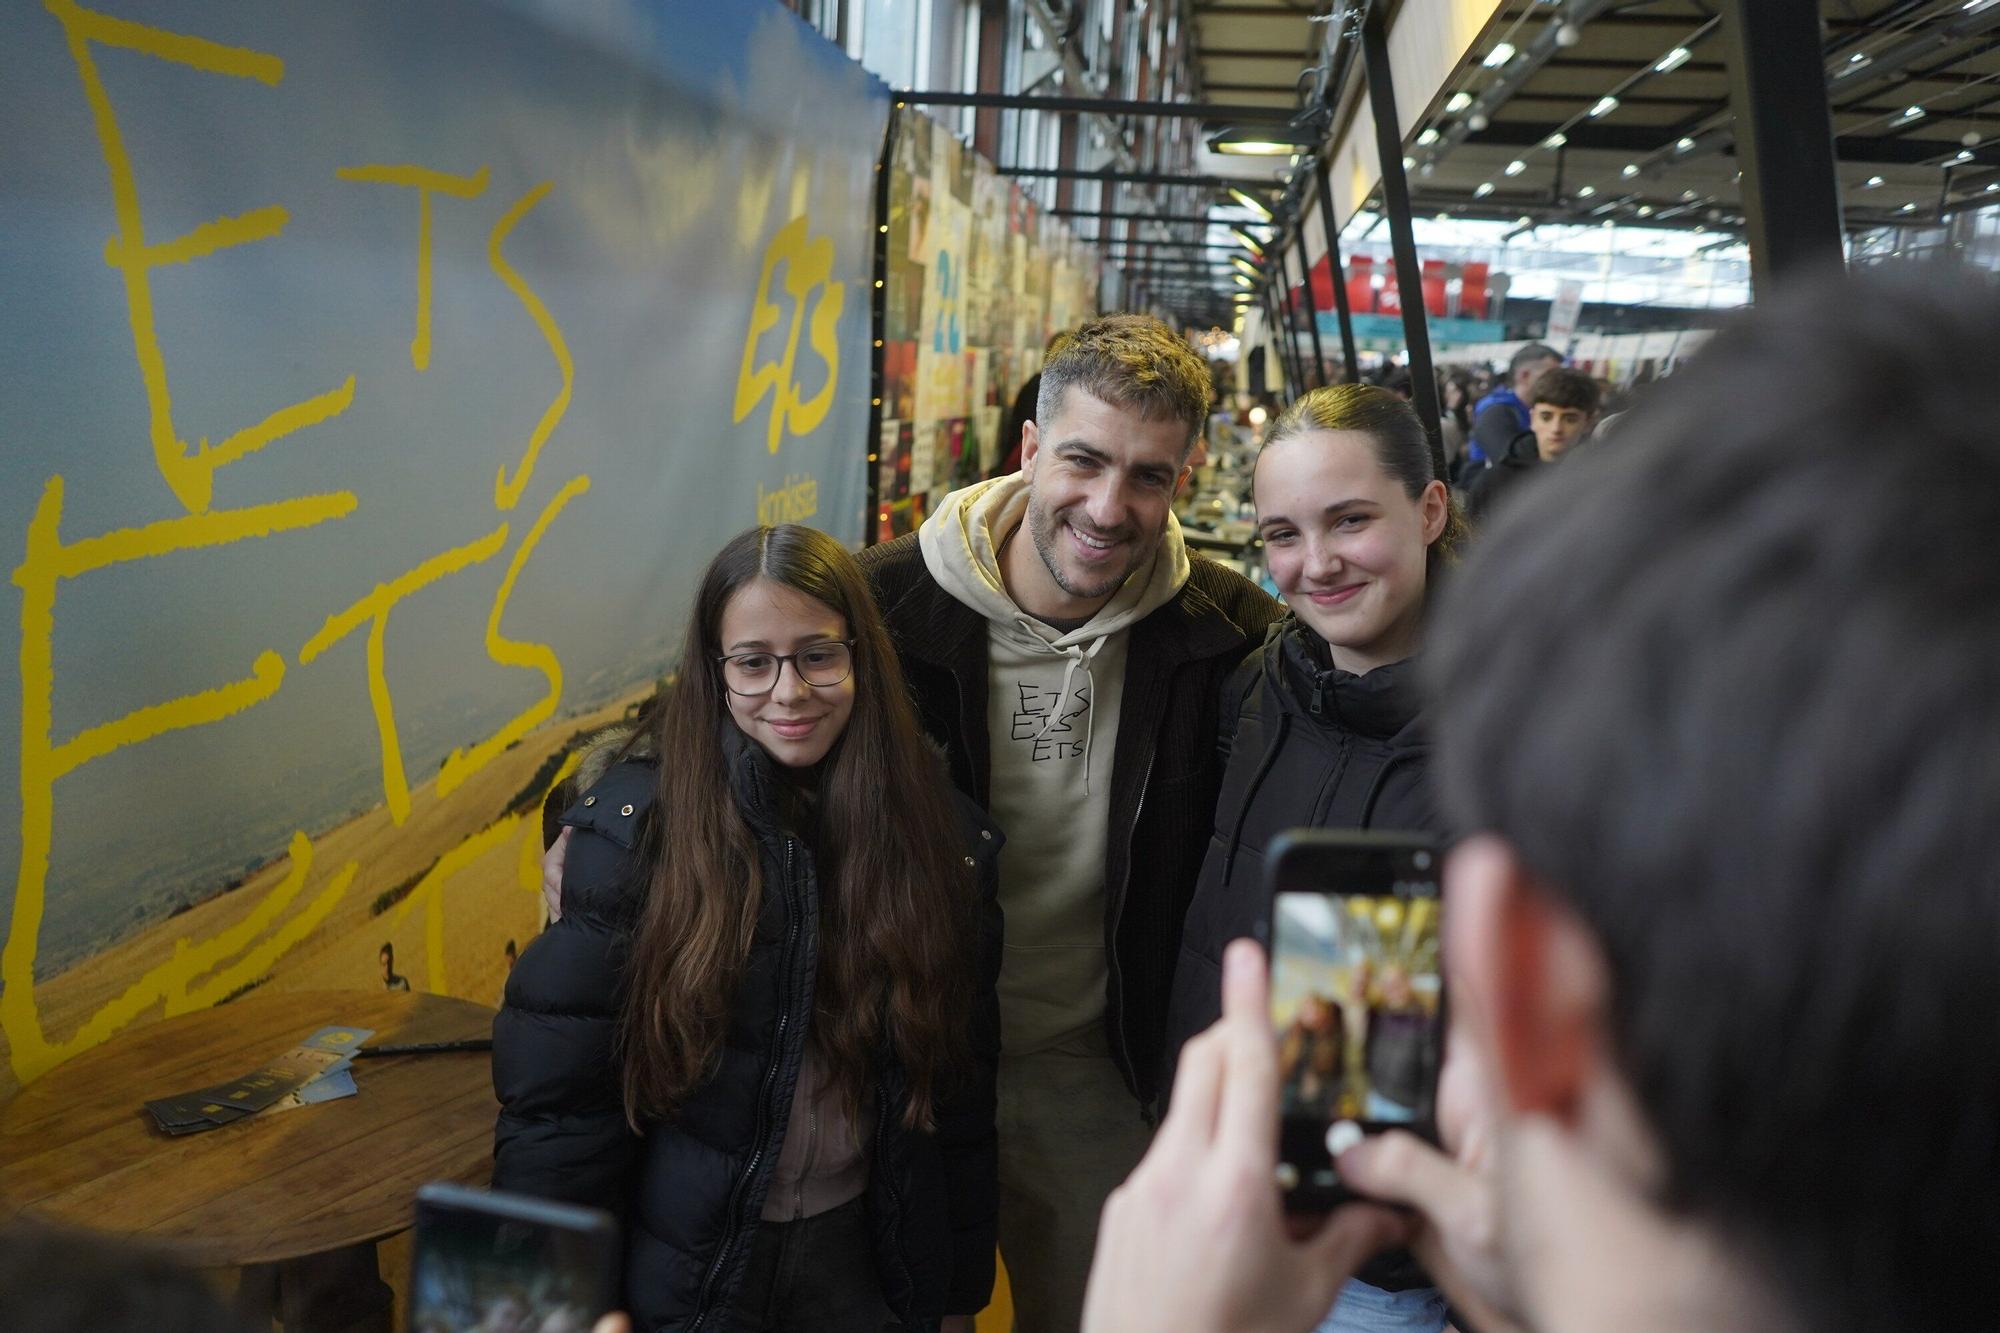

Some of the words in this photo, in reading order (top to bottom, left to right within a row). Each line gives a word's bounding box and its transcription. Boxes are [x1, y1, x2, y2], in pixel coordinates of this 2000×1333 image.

[42, 0, 574, 515] ETS
[733, 215, 845, 454] ETS
[1012, 711, 1073, 740] ETS
[1018, 681, 1090, 718] ETS
[1032, 738, 1084, 761] ETS
[1, 473, 590, 1092] ETS
